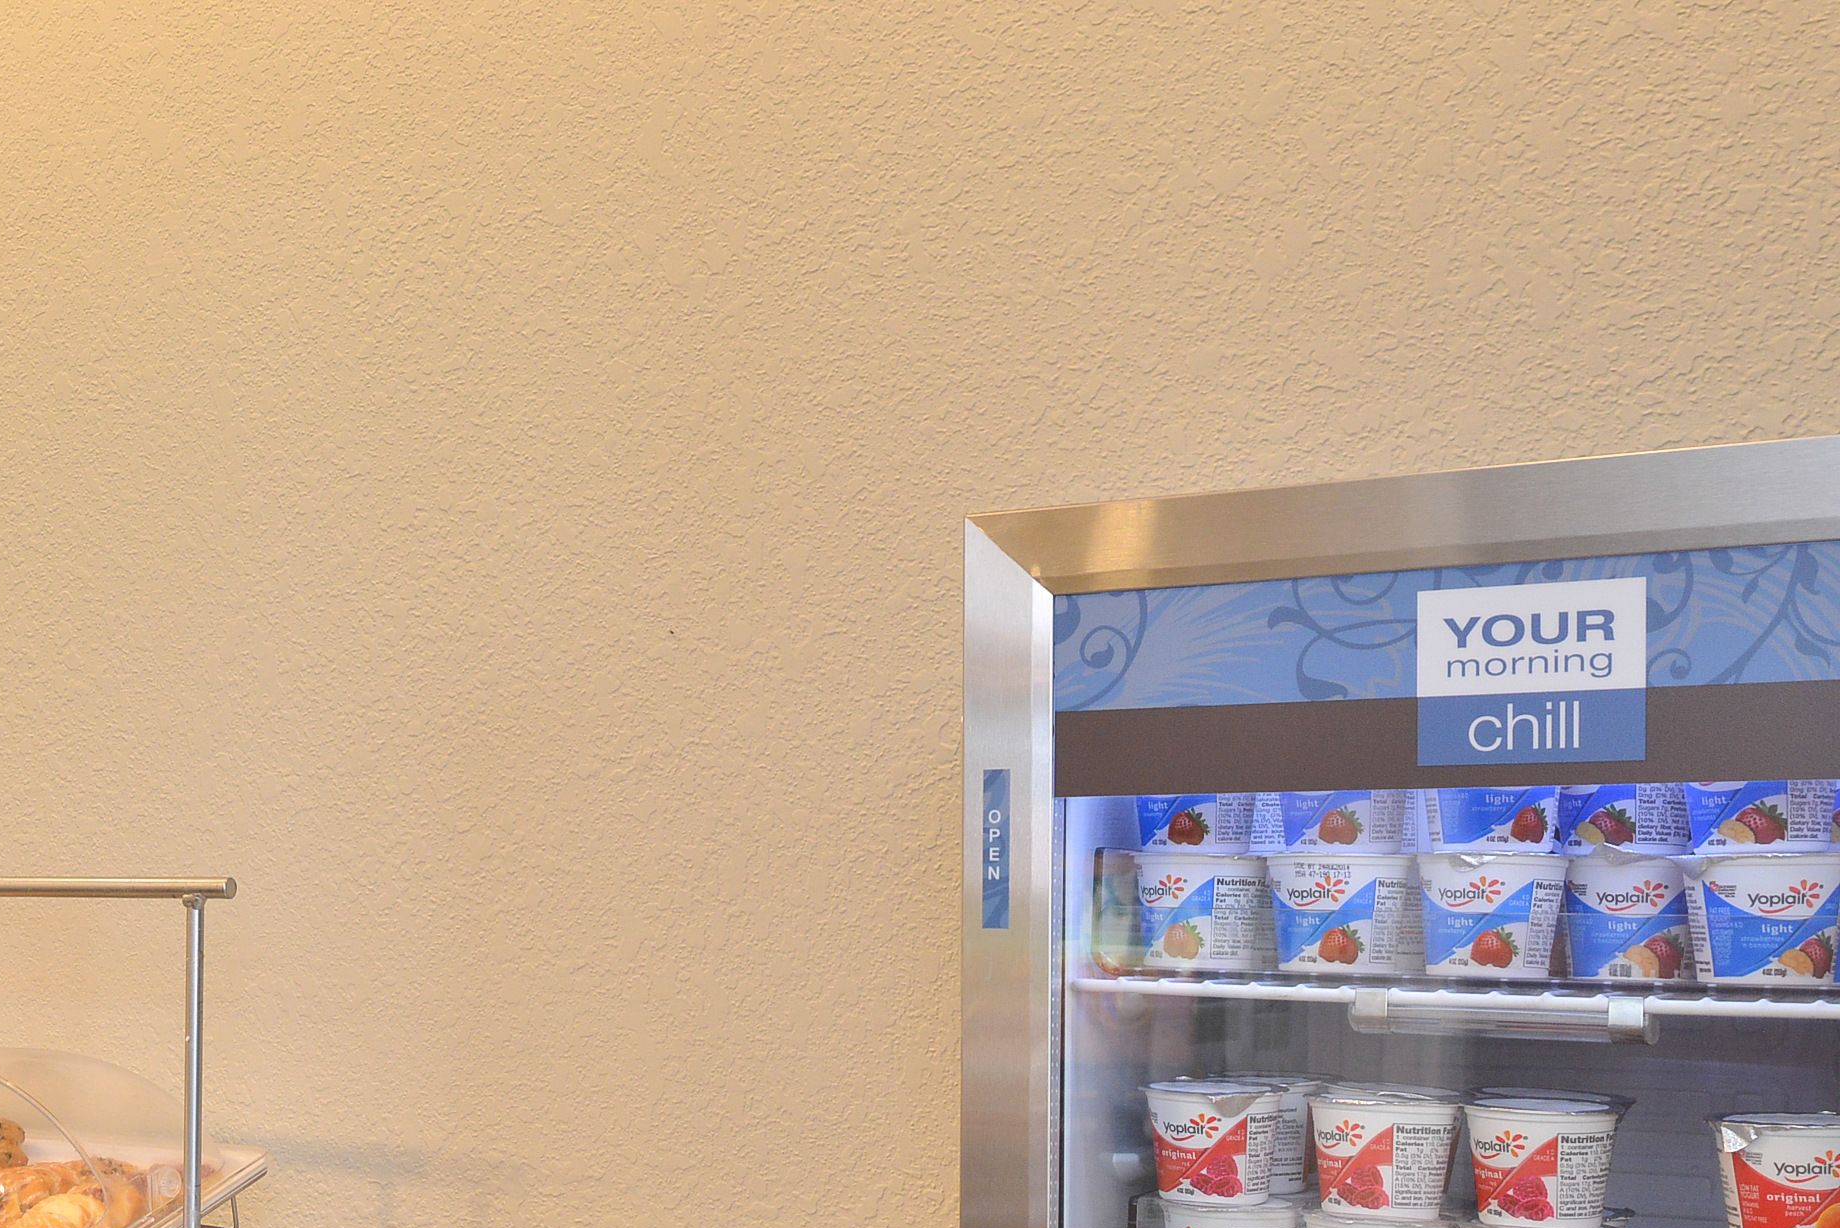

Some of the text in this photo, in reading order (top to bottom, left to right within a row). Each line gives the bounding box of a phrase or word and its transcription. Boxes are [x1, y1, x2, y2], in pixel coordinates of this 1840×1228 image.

[1443, 609, 1615, 648] YOUR
[1447, 649, 1612, 677] morning
[1468, 701, 1580, 752] chill
[1485, 794, 1514, 804] light
[1702, 796, 1726, 806] light
[1296, 800, 1319, 809] light
[988, 810, 1001, 880] OPEN
[1216, 878, 1256, 886] Nutrition
[1296, 916, 1320, 926] light
[1447, 917, 1474, 927] light
[1608, 921, 1638, 931] light
[1762, 924, 1793, 935] light
[1396, 1126, 1441, 1135] Nutrition
[1161, 1150, 1197, 1160] original
[1767, 1193, 1820, 1204] original
